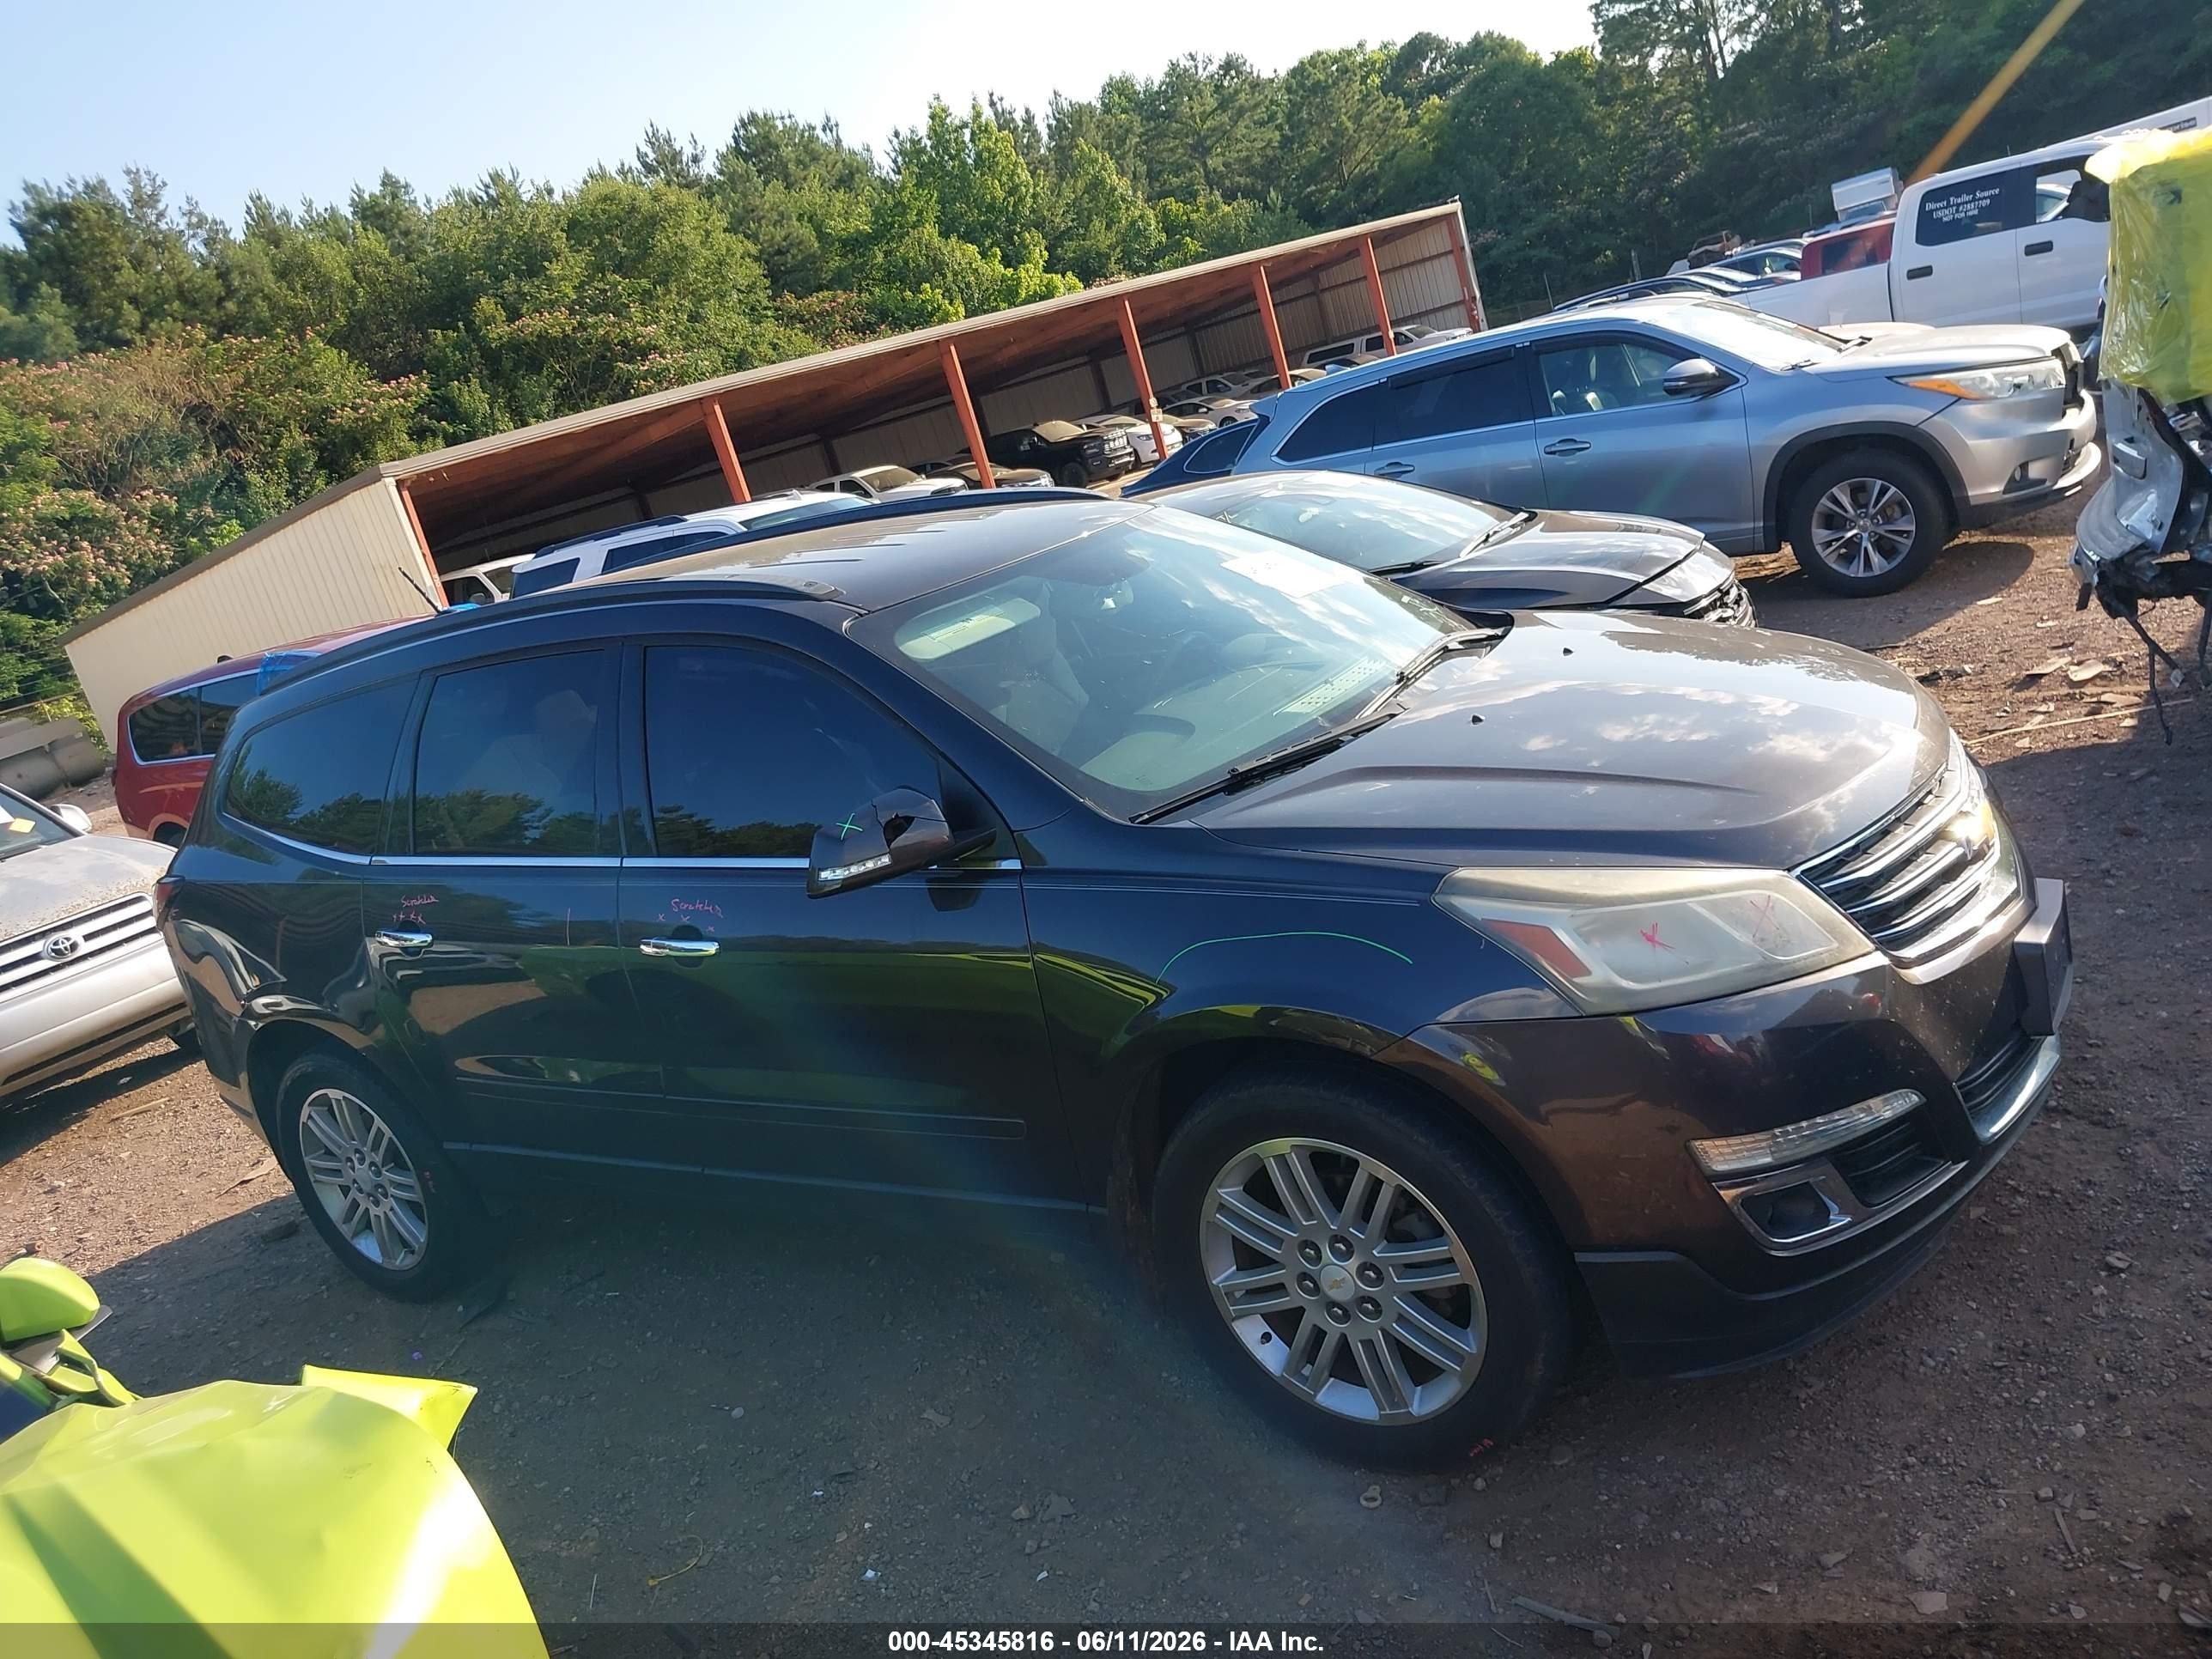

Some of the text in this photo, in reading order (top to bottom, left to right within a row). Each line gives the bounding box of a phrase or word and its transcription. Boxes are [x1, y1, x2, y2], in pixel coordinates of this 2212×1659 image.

[1925, 187, 2000, 211] Direct Trailer Source
[1933, 206, 1957, 219] USDOT
